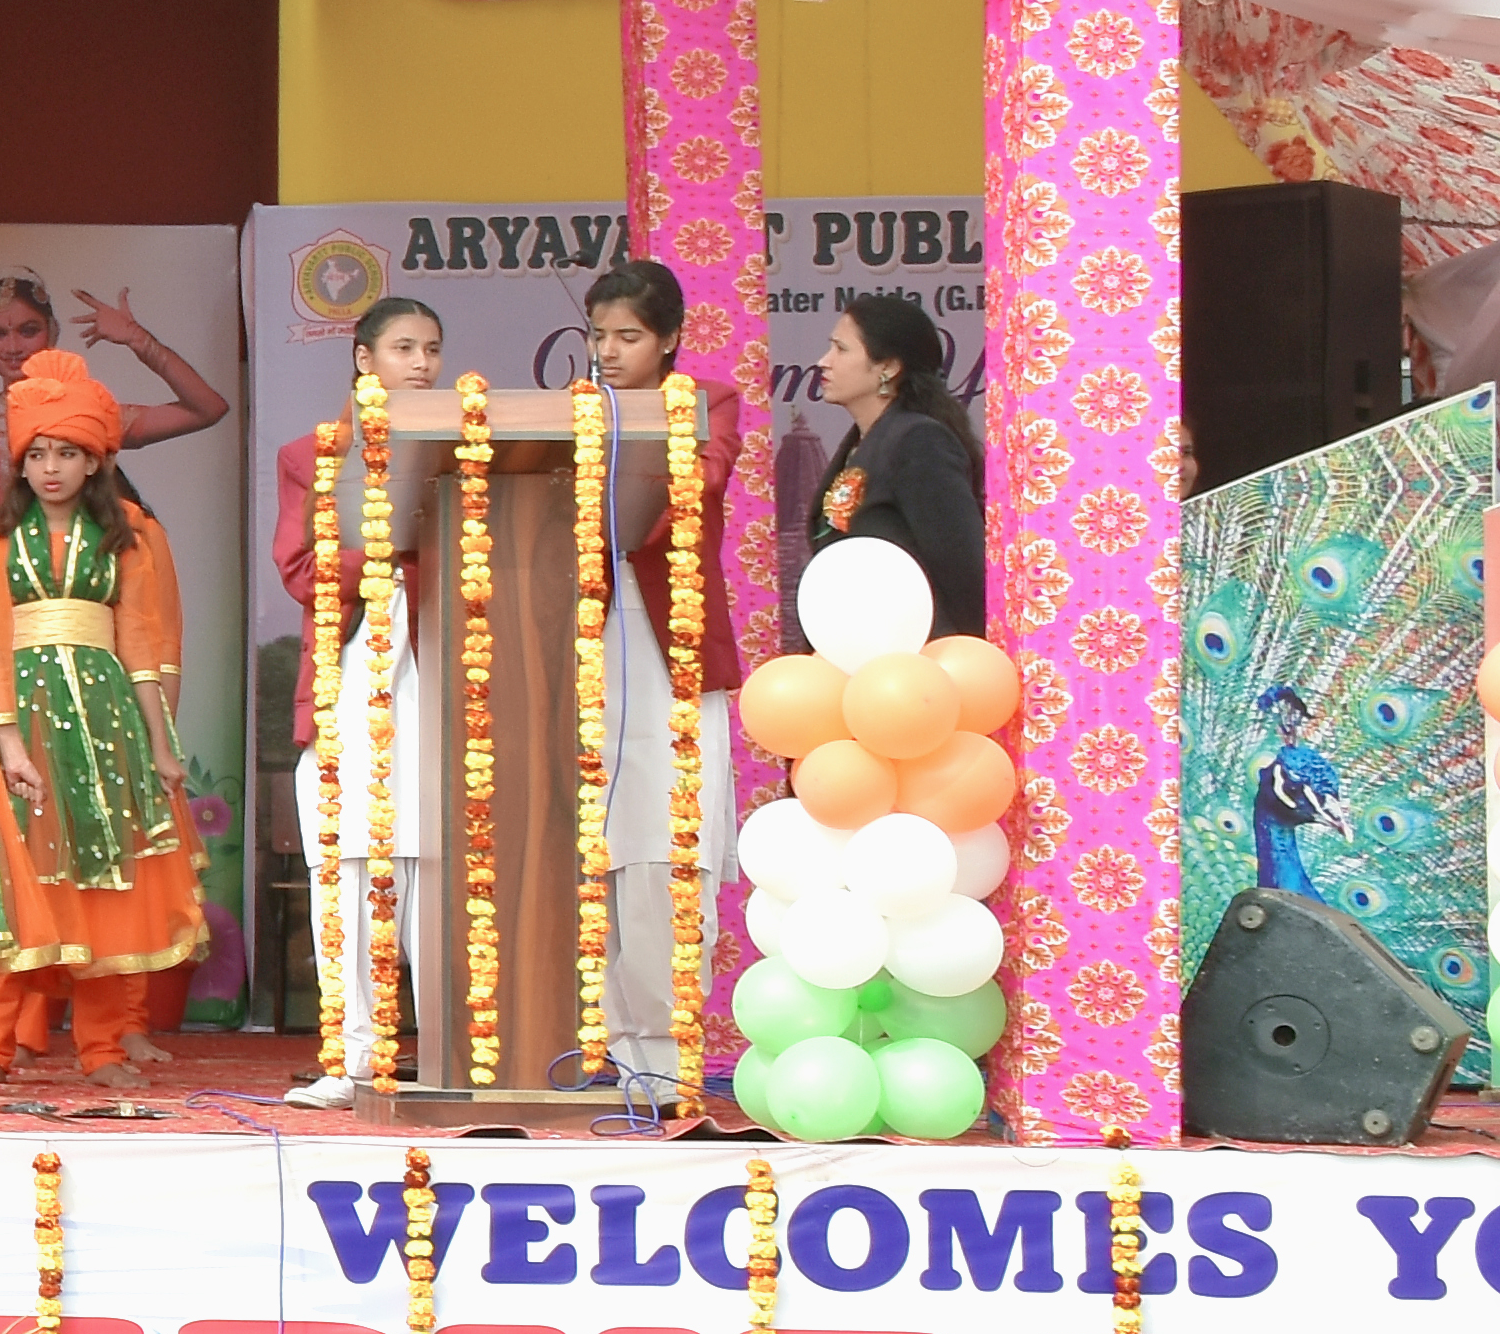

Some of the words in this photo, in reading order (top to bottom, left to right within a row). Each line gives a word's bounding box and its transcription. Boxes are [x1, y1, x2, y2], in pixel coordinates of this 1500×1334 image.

[813, 210, 984, 267] PUBL
[766, 286, 825, 314] ater
[308, 1179, 1279, 1298] WELCOMES
